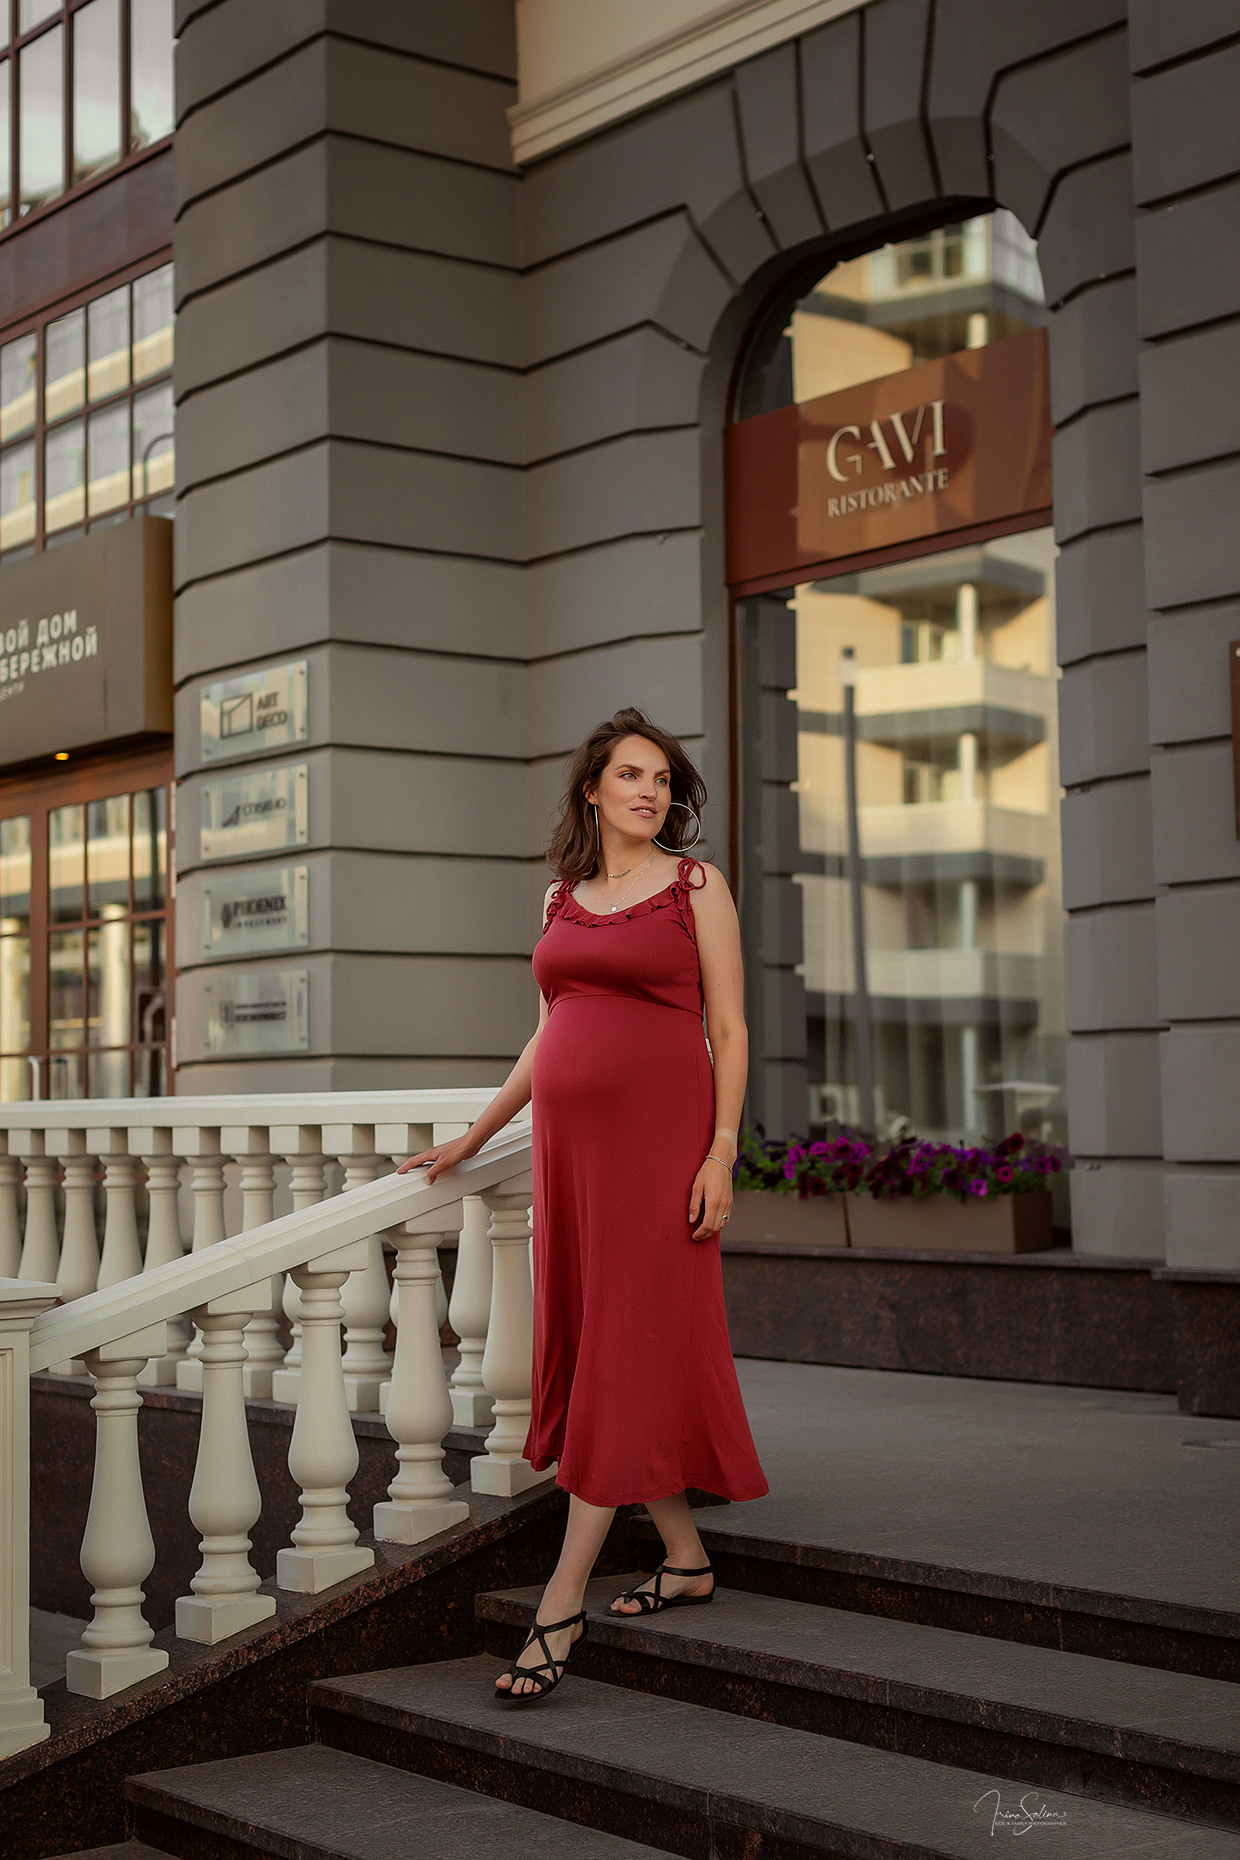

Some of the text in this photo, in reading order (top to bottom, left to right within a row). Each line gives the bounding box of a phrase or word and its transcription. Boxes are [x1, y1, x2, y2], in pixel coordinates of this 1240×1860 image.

[826, 399, 947, 482] GAVI
[827, 466, 950, 518] RISTORANTE
[36, 608, 77, 647] ДОМ
[257, 691, 279, 712] ART
[257, 711, 288, 731] DECO
